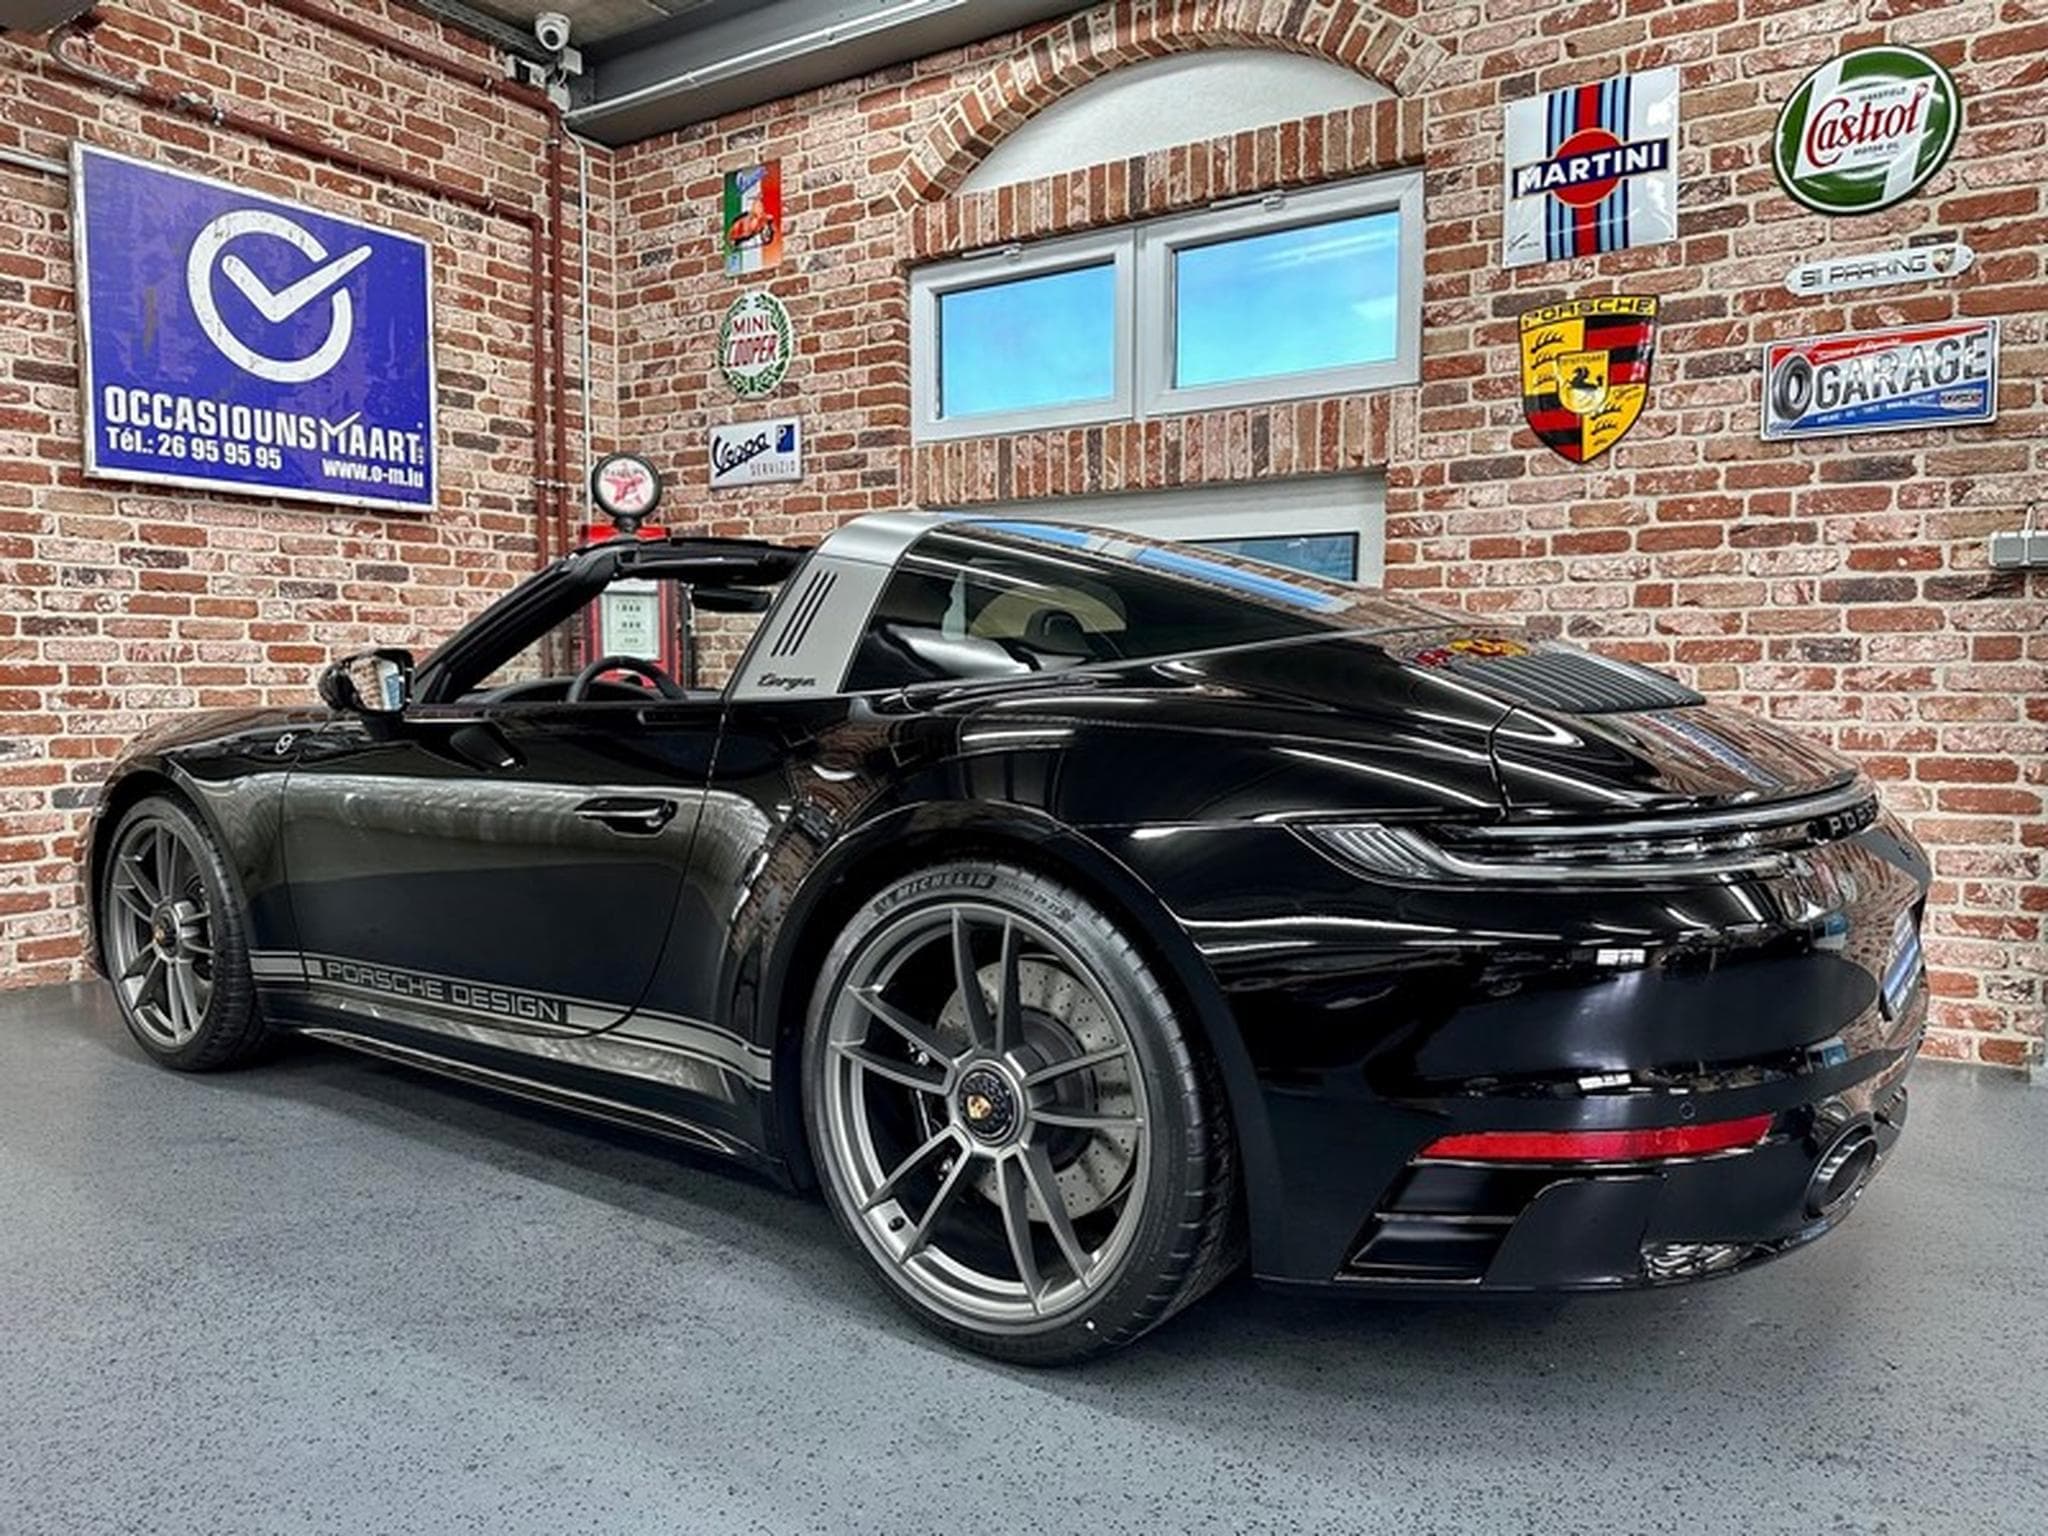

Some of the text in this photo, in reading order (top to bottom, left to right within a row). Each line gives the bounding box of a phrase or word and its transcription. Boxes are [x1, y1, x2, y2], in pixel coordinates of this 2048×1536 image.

[1806, 83, 1930, 168] Castrol
[1517, 142, 1661, 195] MARTINI
[1830, 255, 1927, 284] PARKING
[731, 315, 770, 335] MINI
[1523, 299, 1653, 328] PORSCHE
[726, 334, 778, 367] COOPER
[1816, 330, 1990, 410] GARAGE
[104, 385, 422, 465] OCCASIOUNSMAART
[106, 426, 283, 470] Tél.: 26 95 95 95
[712, 432, 771, 478] Vespa
[322, 459, 425, 488] www.o-m.lu
[750, 460, 796, 477] SERVIZIO
[757, 673, 816, 692] targa
[896, 872, 994, 897] MICHELIN
[326, 961, 560, 1022] PORSCHE DESIGN
